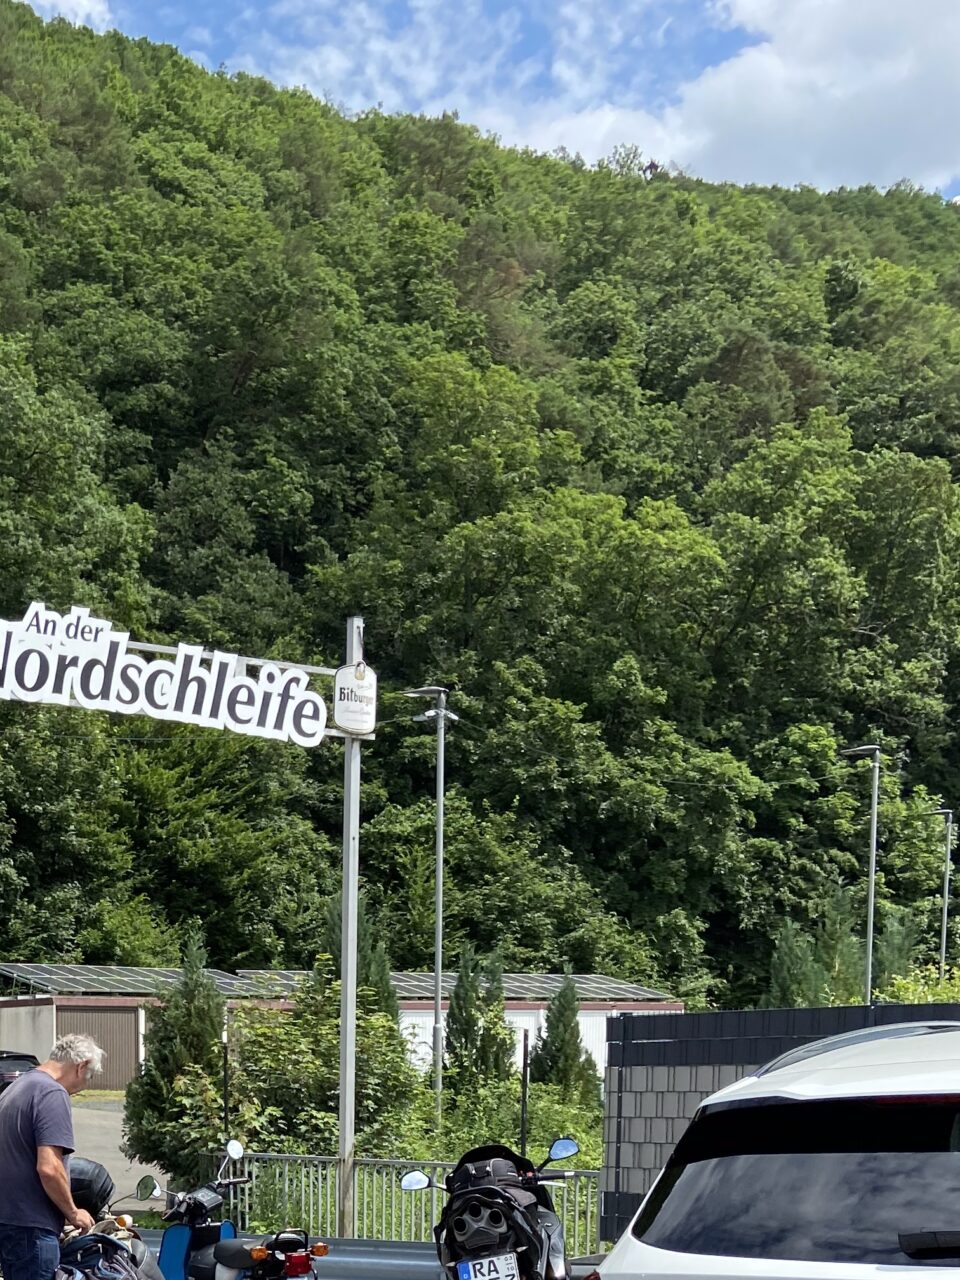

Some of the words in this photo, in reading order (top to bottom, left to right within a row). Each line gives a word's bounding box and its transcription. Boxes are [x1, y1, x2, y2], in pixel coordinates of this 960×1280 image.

[25, 610, 57, 635] An
[65, 615, 104, 643] der
[472, 1259, 500, 1279] RA
